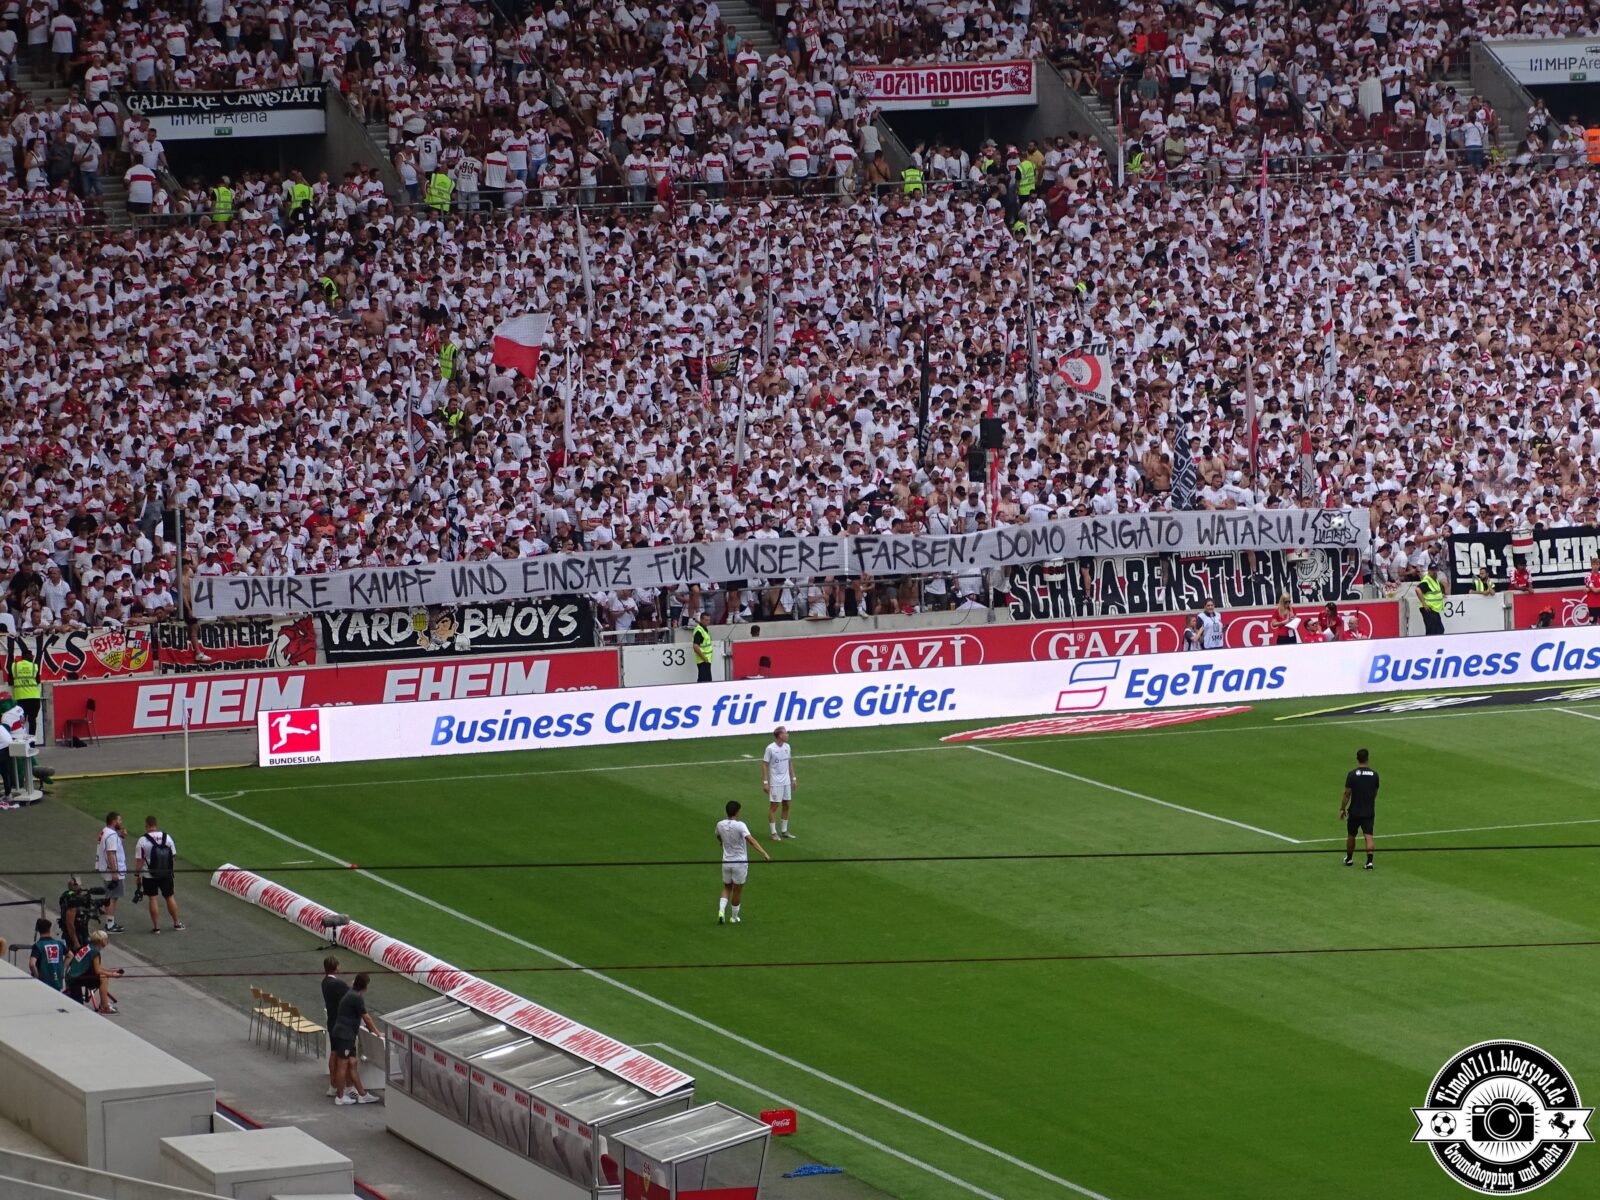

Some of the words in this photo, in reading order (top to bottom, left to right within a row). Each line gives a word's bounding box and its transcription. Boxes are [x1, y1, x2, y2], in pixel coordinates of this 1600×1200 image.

[882, 72, 920, 95] 0711
[926, 69, 1004, 93] ADDICTS
[194, 580, 214, 610] 4
[229, 577, 333, 611] JAHRE
[349, 568, 436, 605] KAMPF
[451, 564, 508, 598] UND
[522, 555, 632, 594] EINSATZ
[646, 546, 710, 583] FÜR
[725, 541, 840, 575] UNSERE
[852, 532, 983, 572] FARBEN!
[990, 525, 1066, 562] DOMO
[1076, 516, 1184, 553] ARIGATO
[1196, 511, 1310, 546] WATARU!
[324, 608, 412, 647] YARD
[463, 604, 579, 640] BWOYS
[1443, 600, 1466, 618] 34
[662, 648, 686, 667] 33
[1367, 648, 1522, 684] Business
[133, 675, 306, 729] EHEIM
[1124, 663, 1288, 706] EgeTrans
[430, 709, 595, 746] Business
[604, 699, 702, 734] Class
[711, 693, 767, 726] für
[773, 690, 843, 722] Ihre
[853, 683, 957, 717] Güter.
[269, 755, 321, 766] BUNDESLIGA
